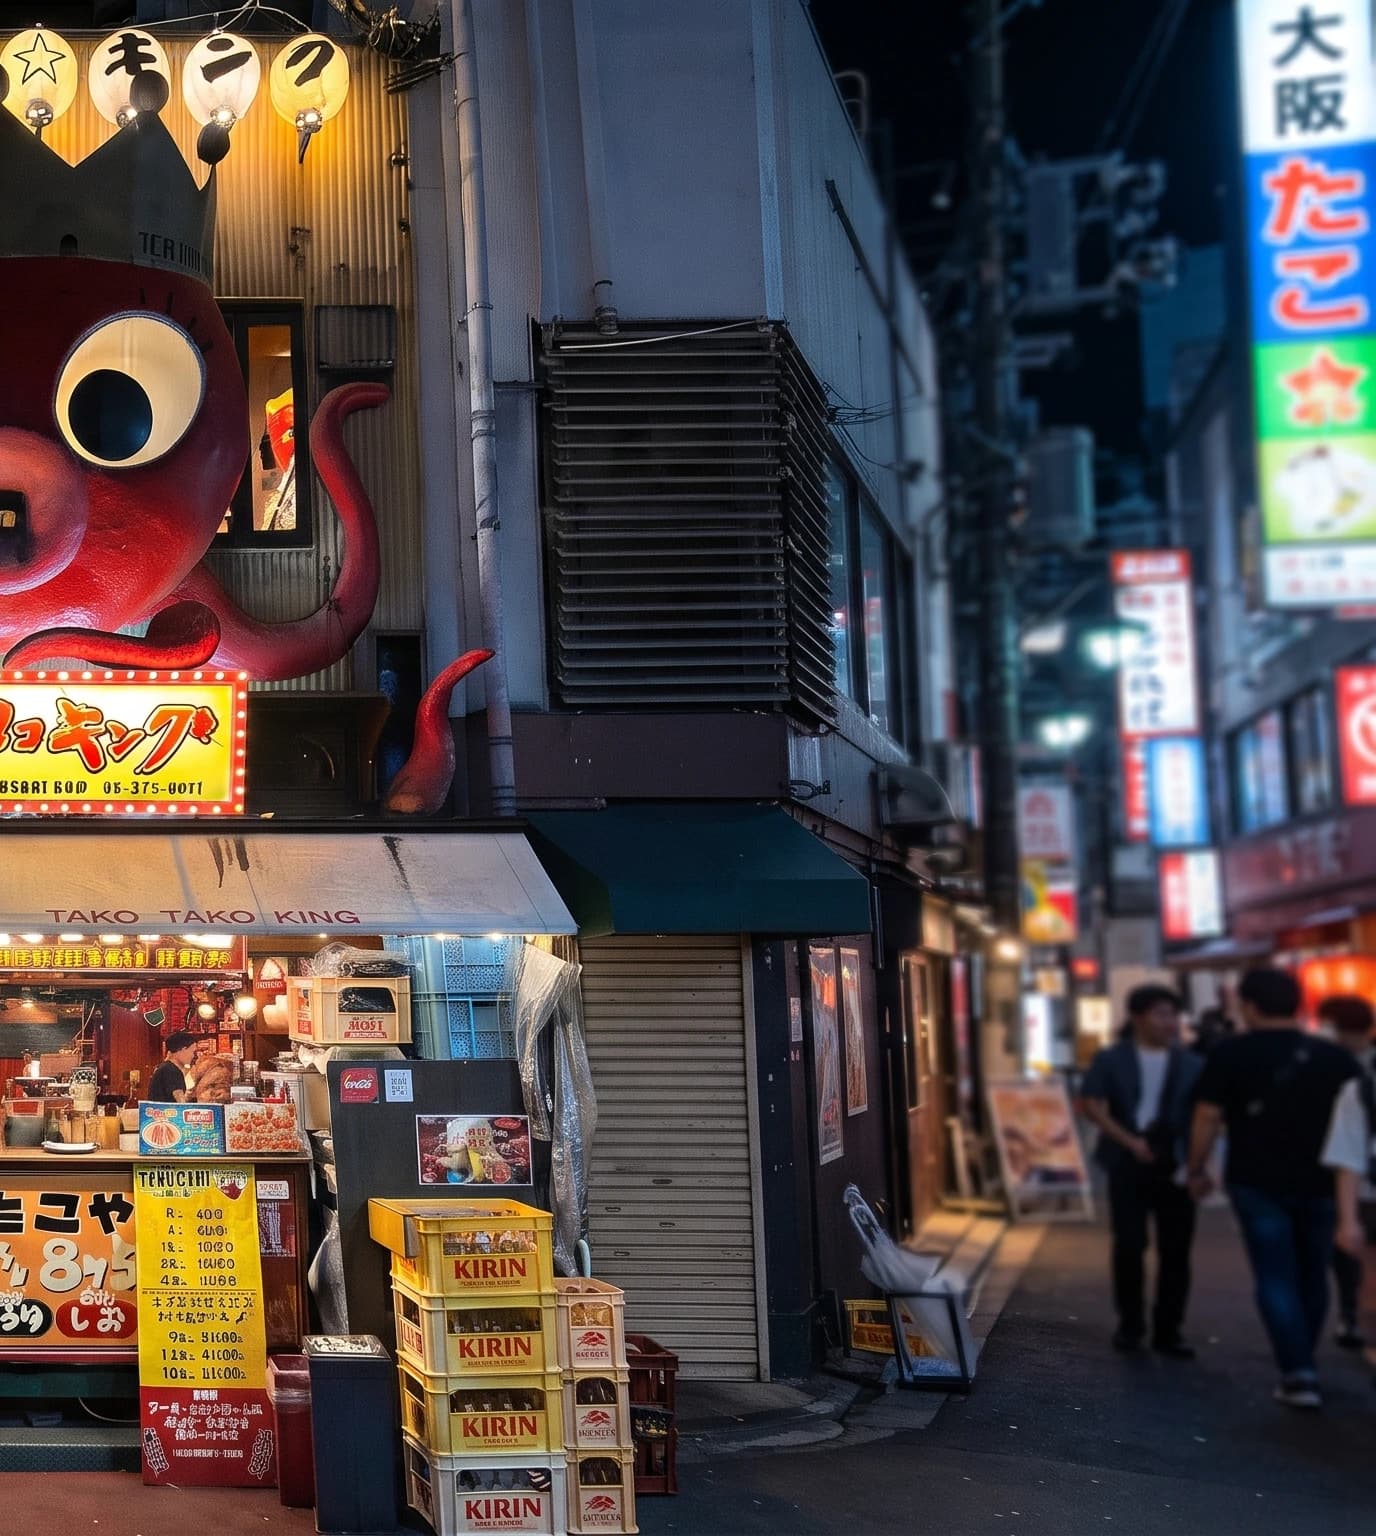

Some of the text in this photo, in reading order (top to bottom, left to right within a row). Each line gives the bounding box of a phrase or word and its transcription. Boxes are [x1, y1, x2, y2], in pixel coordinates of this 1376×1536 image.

[1265, 6, 1366, 327] 大阪 たこ
[45, 909, 362, 924] TAKO TAKO KING
[454, 1257, 527, 1279] KIRIN
[458, 1336, 532, 1359] KIRIN
[462, 1415, 538, 1438] KIRIN
[465, 1497, 542, 1519] KIRIN
